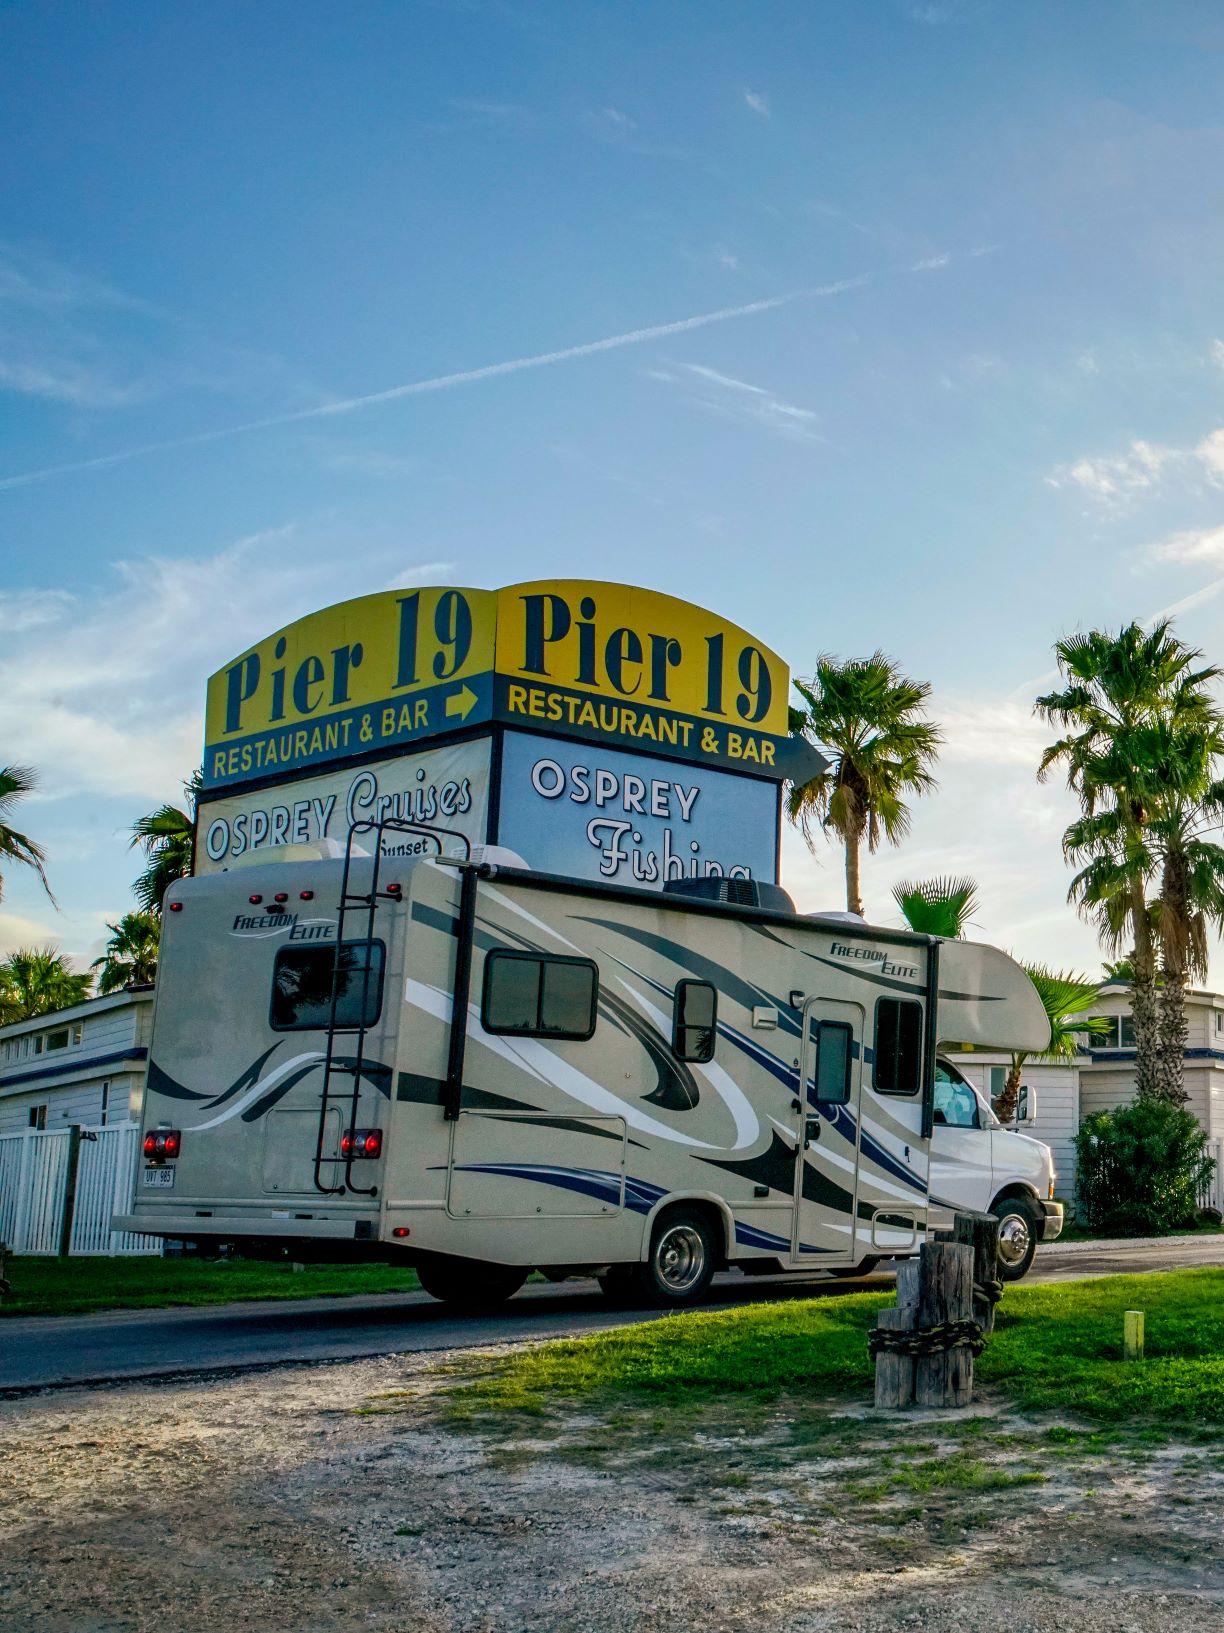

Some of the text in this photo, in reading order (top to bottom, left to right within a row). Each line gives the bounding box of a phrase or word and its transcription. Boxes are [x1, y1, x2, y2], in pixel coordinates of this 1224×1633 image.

[222, 590, 473, 735] Pier 19
[518, 594, 772, 723] Pier 19
[213, 698, 429, 779] RESTAURANT & BAR
[508, 683, 776, 766] RESTAURANT & BAR
[206, 768, 472, 861] OSPREY Cruises
[531, 758, 701, 823] OSPREY
[232, 912, 299, 931] FREEDOM
[288, 923, 336, 940] ELITE
[829, 942, 888, 961] FREEDOM
[881, 961, 919, 978] ELITE
